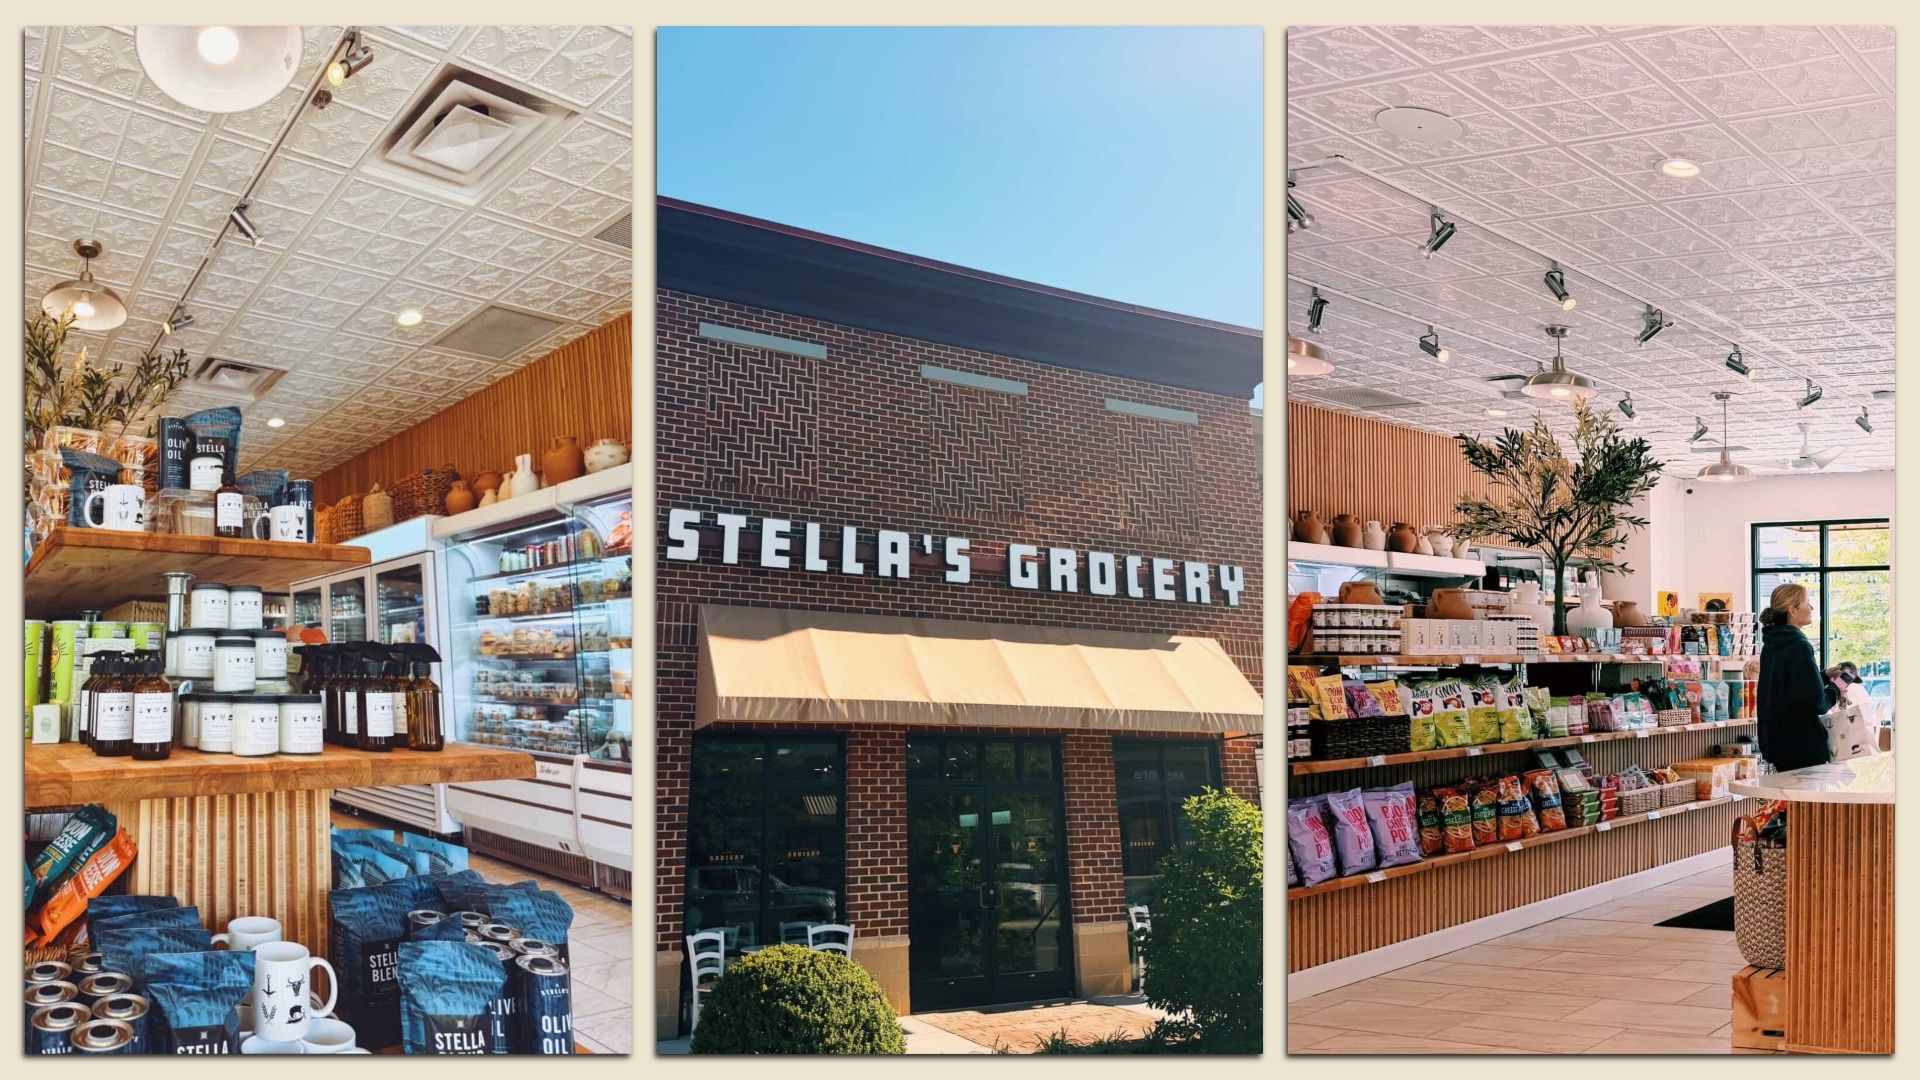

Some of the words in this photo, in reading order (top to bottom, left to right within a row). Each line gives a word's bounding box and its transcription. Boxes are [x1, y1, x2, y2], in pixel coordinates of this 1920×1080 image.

[168, 450, 182, 460] OIL
[197, 444, 225, 453] STELLA
[667, 508, 970, 583] STELLA'S
[1009, 543, 1244, 606] GROCERY
[369, 953, 398, 969] STELL
[372, 969, 398, 982] BLEN
[435, 1030, 486, 1051] STELLA
[543, 1037, 569, 1055] OIL
